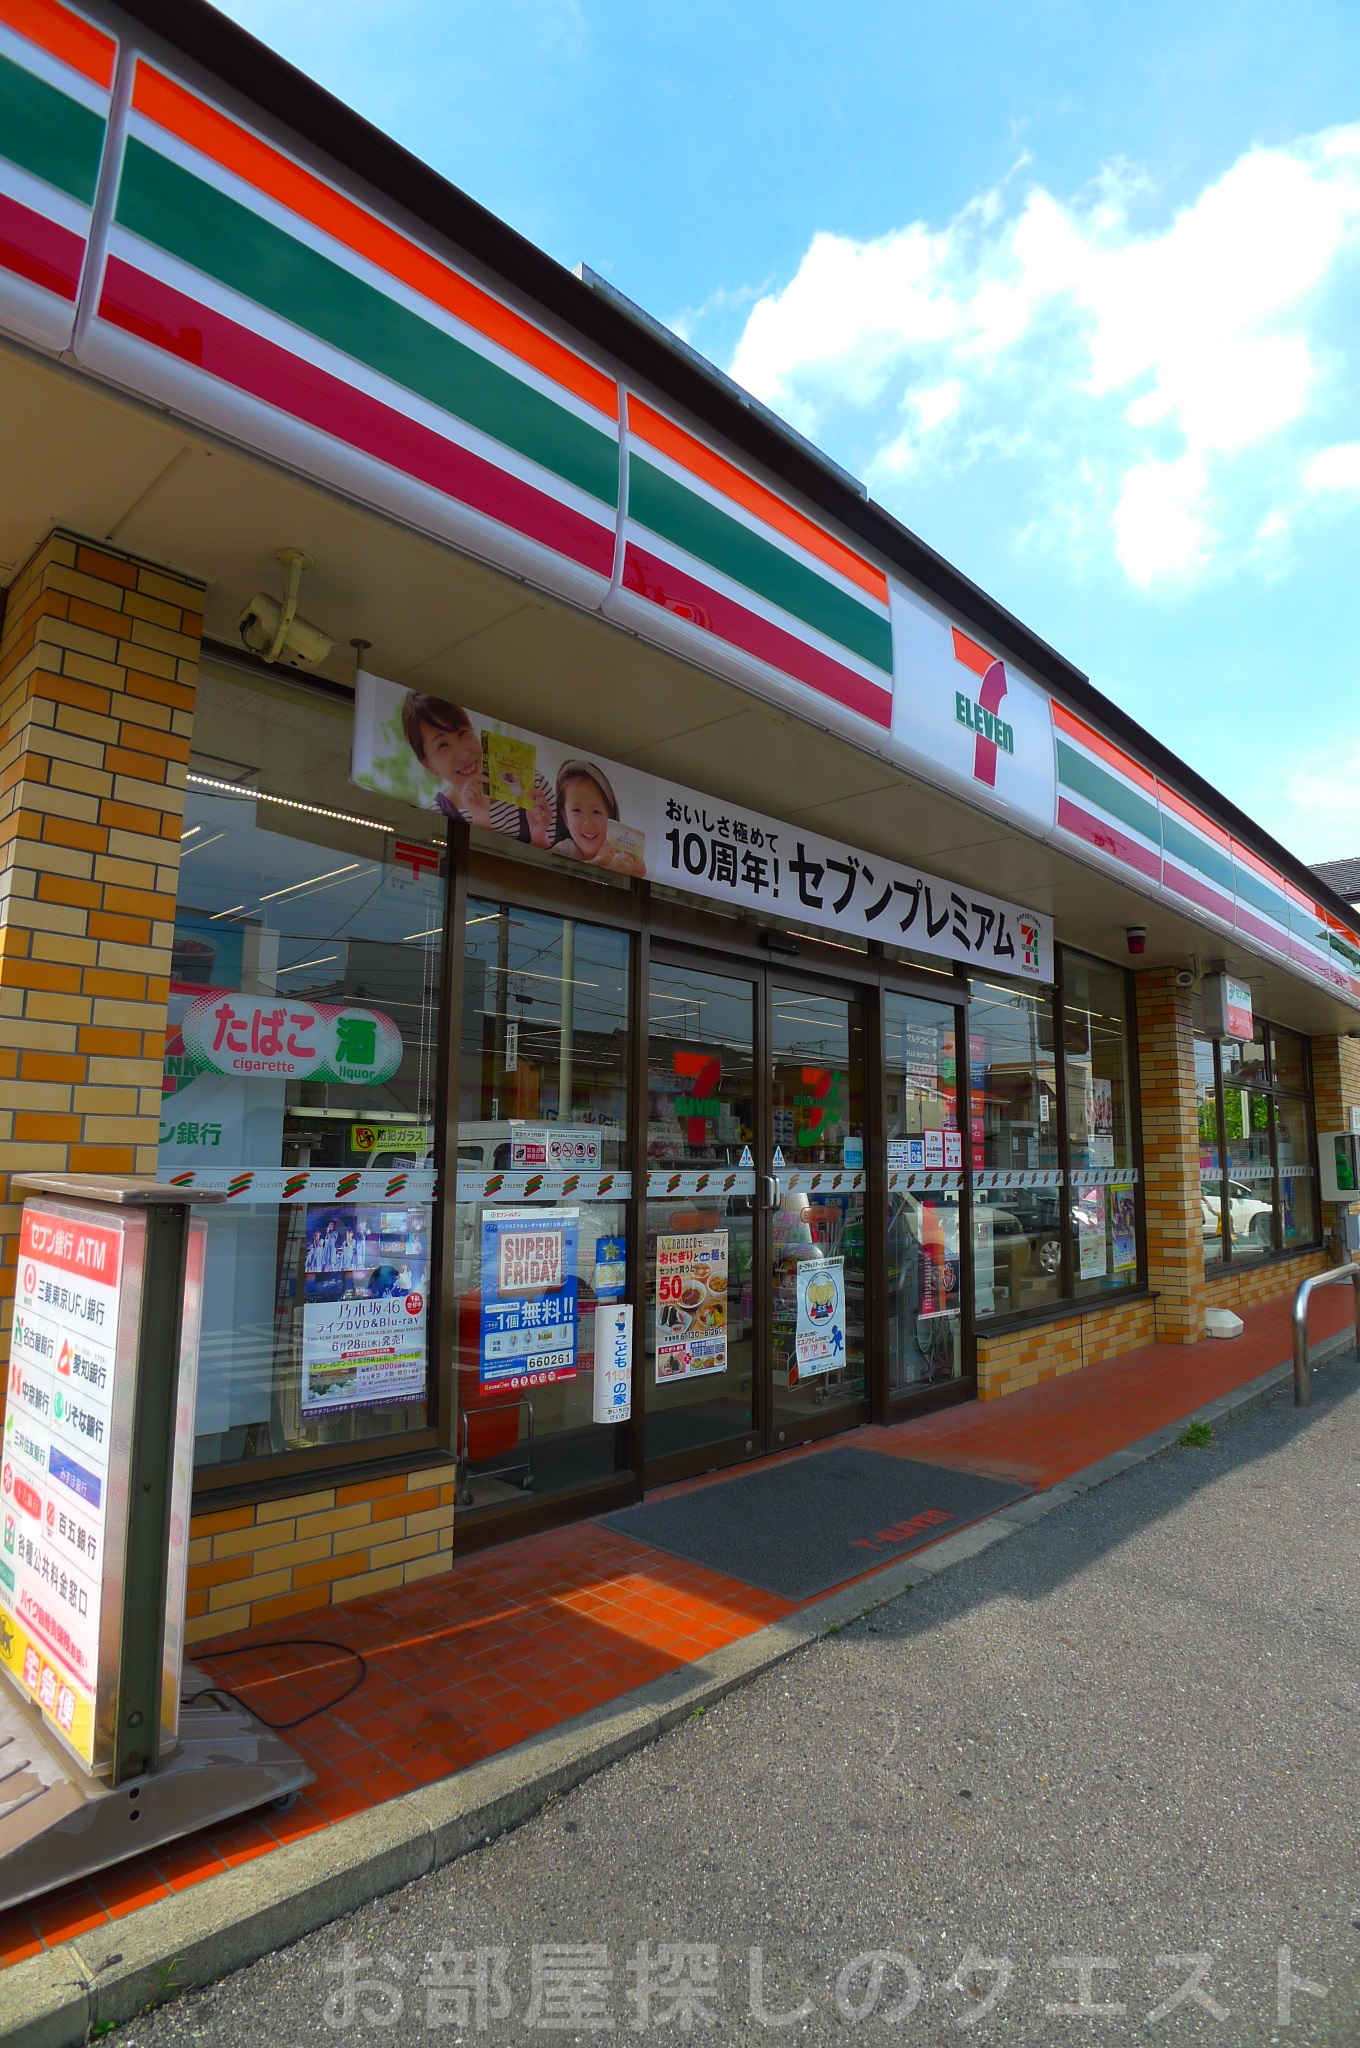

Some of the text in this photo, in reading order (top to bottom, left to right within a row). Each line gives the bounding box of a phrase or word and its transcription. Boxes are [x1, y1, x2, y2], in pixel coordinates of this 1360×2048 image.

[665, 799, 780, 854] おいしさ極めて
[788, 841, 1015, 960] セブンプレミアム
[1021, 964, 1040, 975] PREMIUM
[213, 1003, 317, 1057] たばこ
[336, 1017, 377, 1065] 酒
[232, 1057, 296, 1073] cigarette
[339, 1065, 376, 1080] liquor
[378, 1130, 424, 1141] 防犯ガラス
[31, 1221, 107, 1271] セブン銀行 ATM
[504, 1236, 559, 1262] SUPER!
[504, 1259, 559, 1287] FRIDAY
[659, 1264, 695, 1275] セットで買うと
[37, 1279, 106, 1326] 三菱東京UFJ銀行
[659, 1275, 683, 1300] 50
[316, 1316, 420, 1334] ライブDVD&Blu-ray
[338, 1300, 400, 1319] 乃木坂46
[817, 1305, 827, 1313] SS
[23, 1326, 55, 1359] 名古屋銀行
[72, 1353, 107, 1389] 愛知銀行
[529, 1353, 571, 1368] 660261
[22, 1379, 50, 1415] 中京銀行
[65, 1400, 104, 1444] りそな銀行
[14, 1430, 46, 1466] 三井住友銀行
[60, 1466, 88, 1497] みずほ銀行
[58, 1511, 97, 1561] 百五銀行
[18, 1533, 88, 1619] 各種公共料金窓口
[22, 1641, 76, 1735] 宅急便
